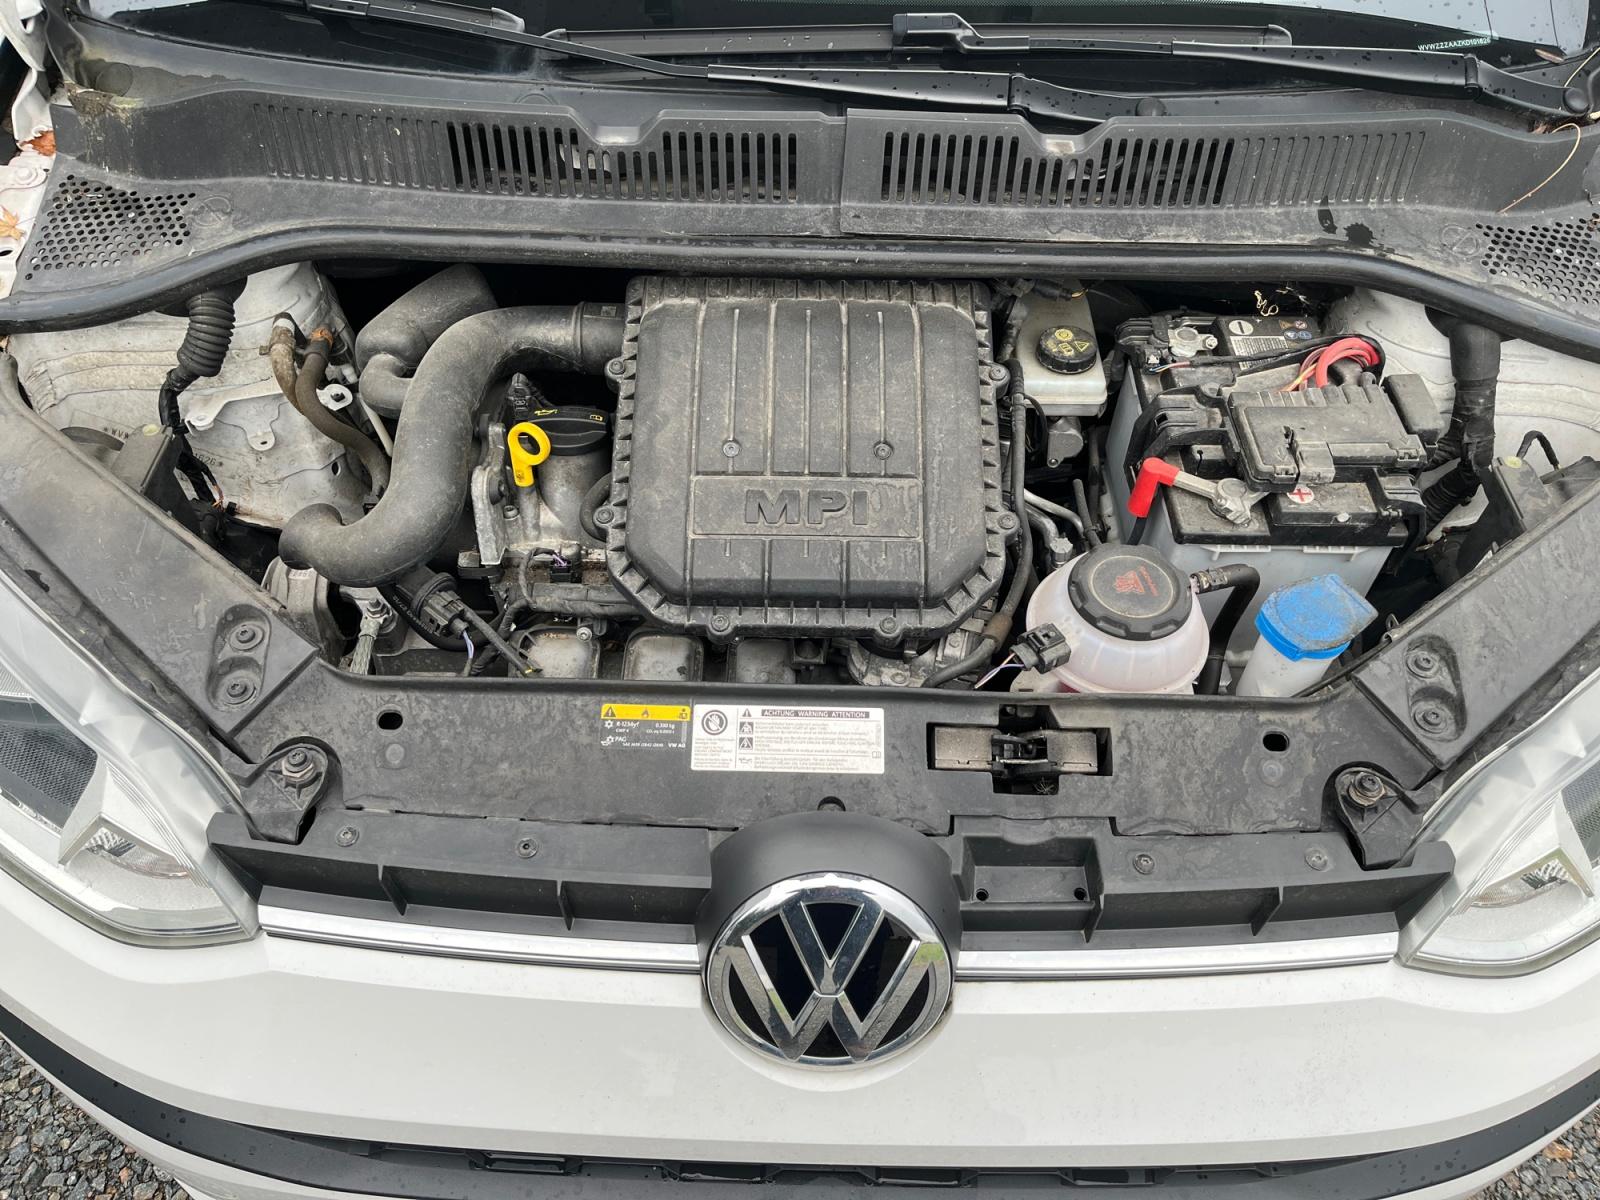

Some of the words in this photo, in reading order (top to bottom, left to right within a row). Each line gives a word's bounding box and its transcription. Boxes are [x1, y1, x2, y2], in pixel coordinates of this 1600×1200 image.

[745, 489, 869, 526] MPI
[763, 709, 795, 717] ACHTUNG
[718, 888, 942, 1064] VW
